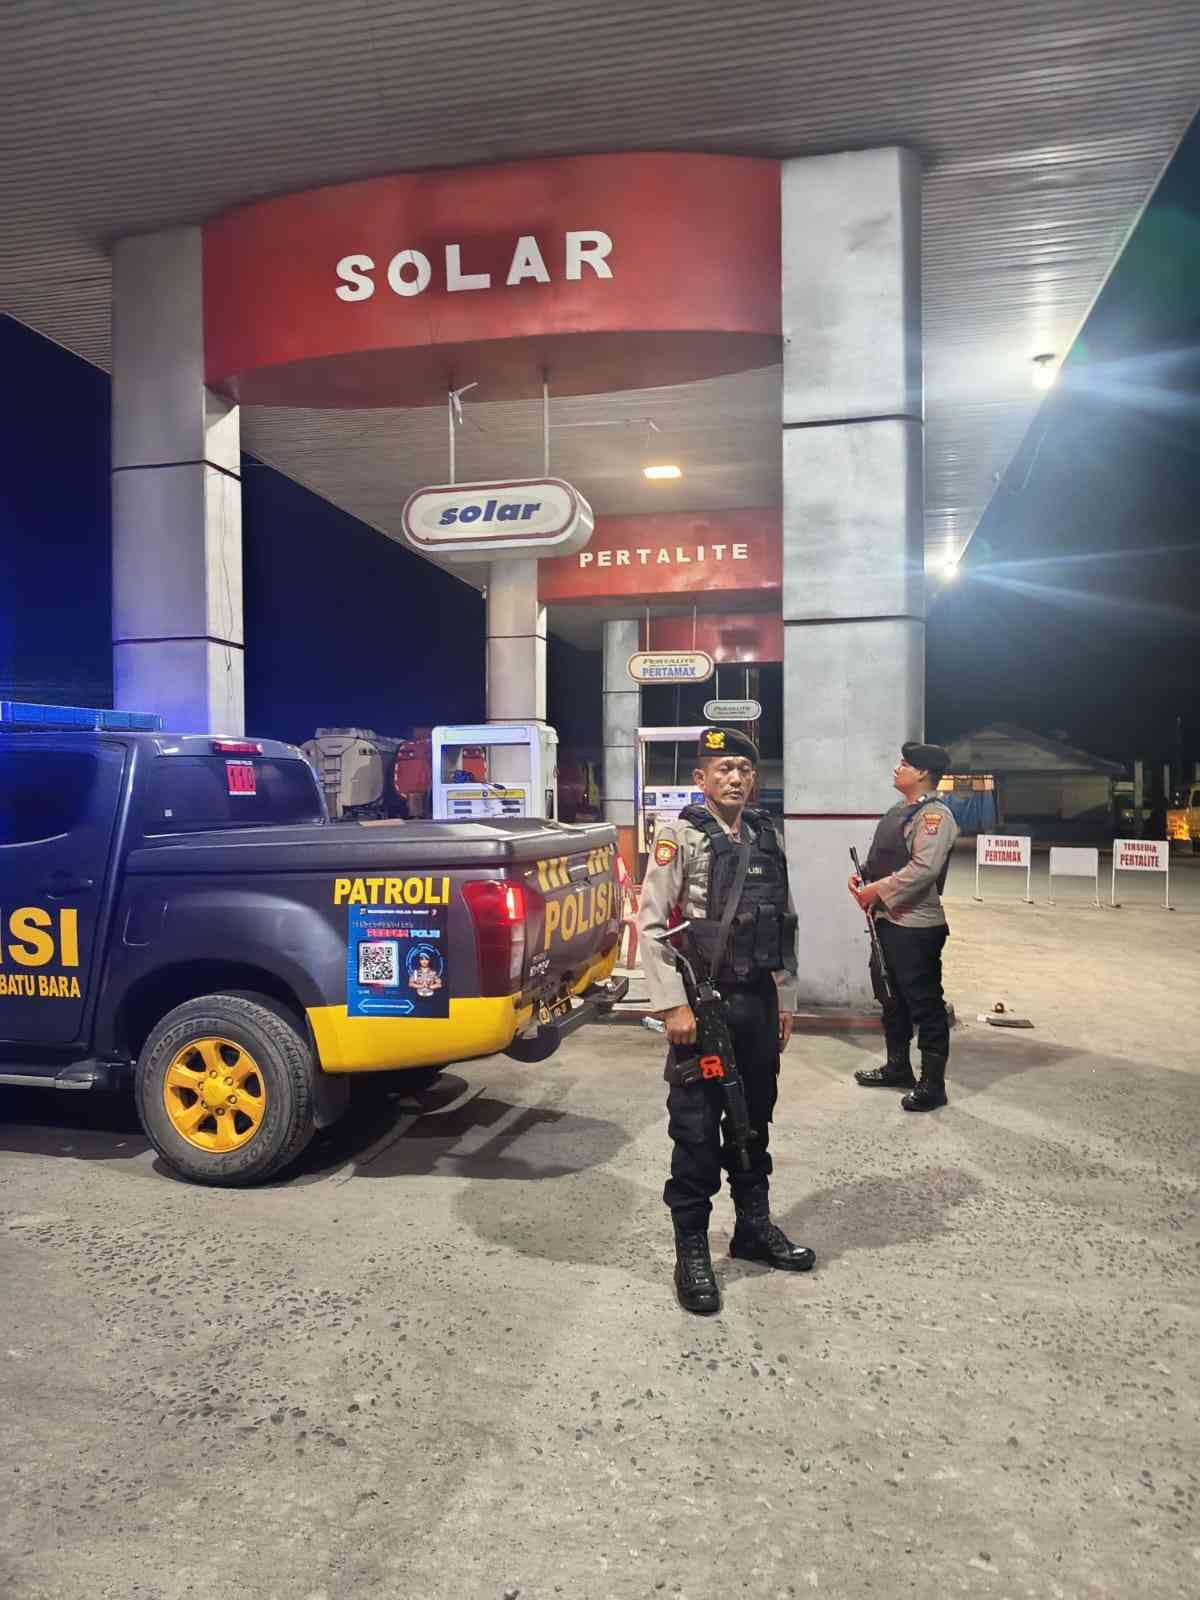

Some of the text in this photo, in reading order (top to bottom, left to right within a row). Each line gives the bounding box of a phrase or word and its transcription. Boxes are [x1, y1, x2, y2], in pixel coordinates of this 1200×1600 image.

[336, 230, 613, 301] SOLAR
[439, 500, 541, 525] solar
[579, 543, 749, 568] PERTALITE
[642, 666, 696, 677] PERTAMAX
[987, 839, 1019, 848] TRSEDIA
[985, 850, 1021, 864] PERTAMAX
[1120, 854, 1159, 868] PERTALITE
[334, 877, 450, 905] PATROLI
[544, 881, 612, 951] POLISI
[0, 907, 80, 967] SI
[0, 974, 81, 998] BATU BARA
